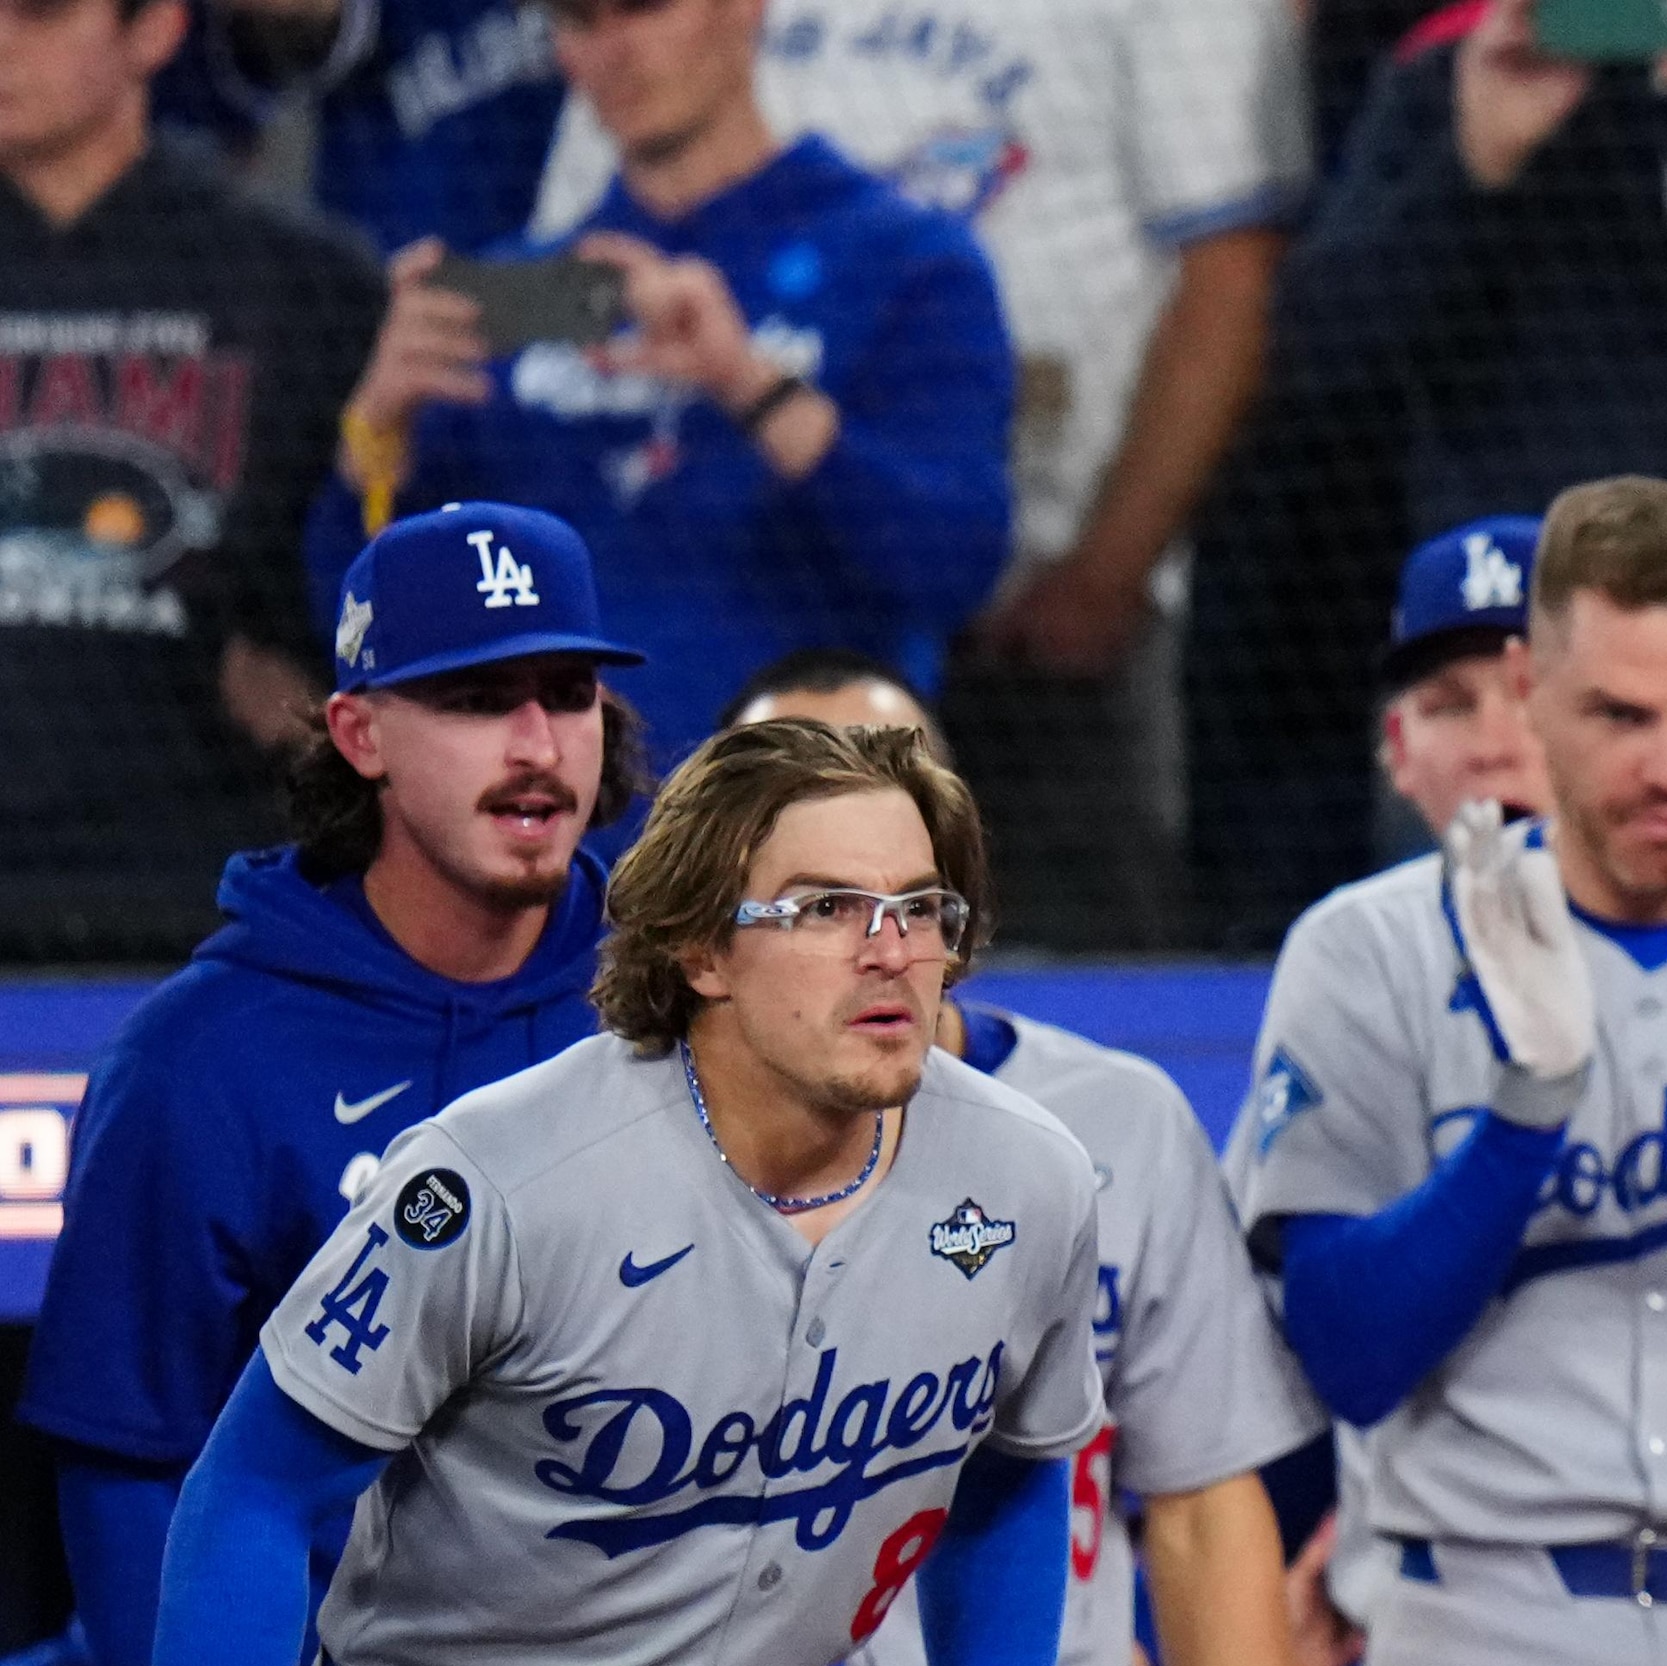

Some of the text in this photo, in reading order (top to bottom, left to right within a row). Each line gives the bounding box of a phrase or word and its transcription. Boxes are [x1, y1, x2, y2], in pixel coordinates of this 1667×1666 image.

[467, 530, 540, 608] LA
[1461, 532, 1522, 611] LA
[404, 1189, 452, 1242] 34
[426, 1175, 462, 1214] FERNANDO
[304, 1221, 391, 1375] LA
[534, 1338, 1005, 1553] Dodgers
